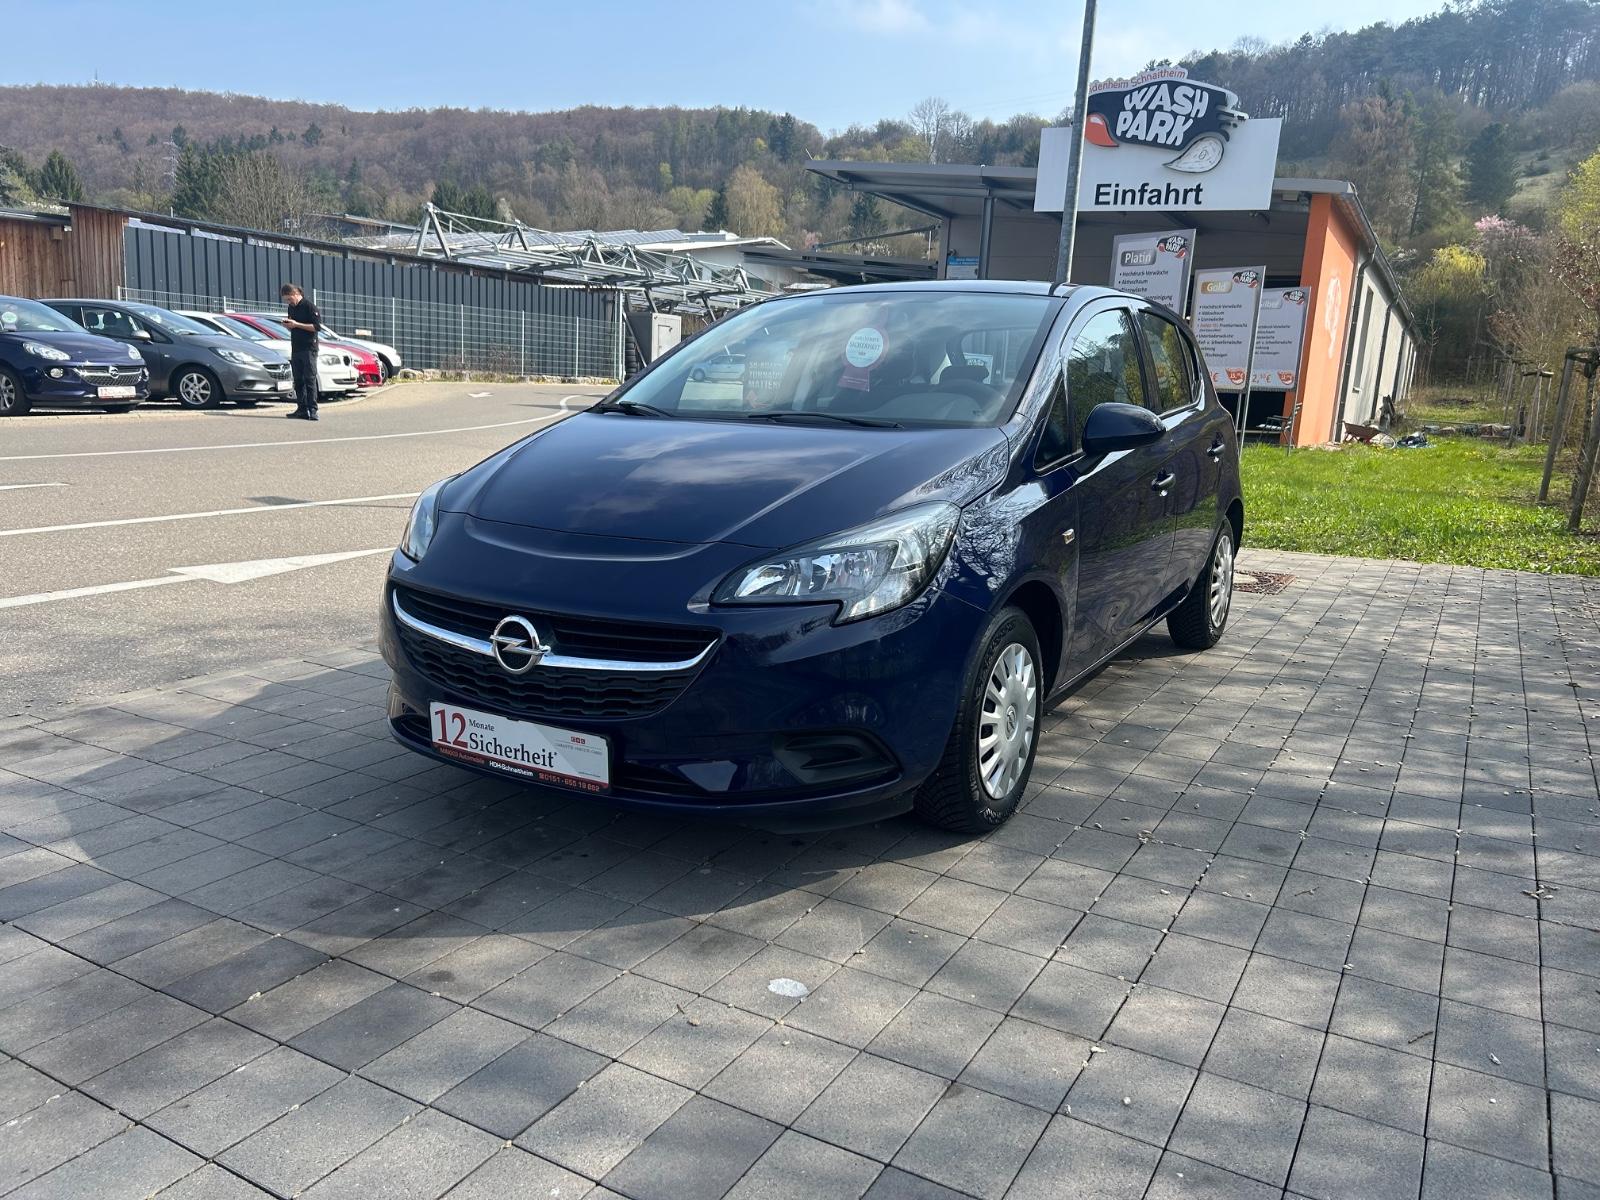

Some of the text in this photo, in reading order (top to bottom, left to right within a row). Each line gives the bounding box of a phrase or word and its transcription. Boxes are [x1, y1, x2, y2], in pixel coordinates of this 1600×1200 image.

[1089, 69, 1186, 93] idenheim Schnaitheim
[1123, 83, 1209, 118] WASH
[1116, 110, 1193, 146] PARK
[1094, 182, 1203, 206] Einfahrt
[1124, 251, 1152, 264] Platin
[1207, 281, 1226, 292] Gold
[434, 709, 468, 749] 12
[468, 718, 495, 732] Monate
